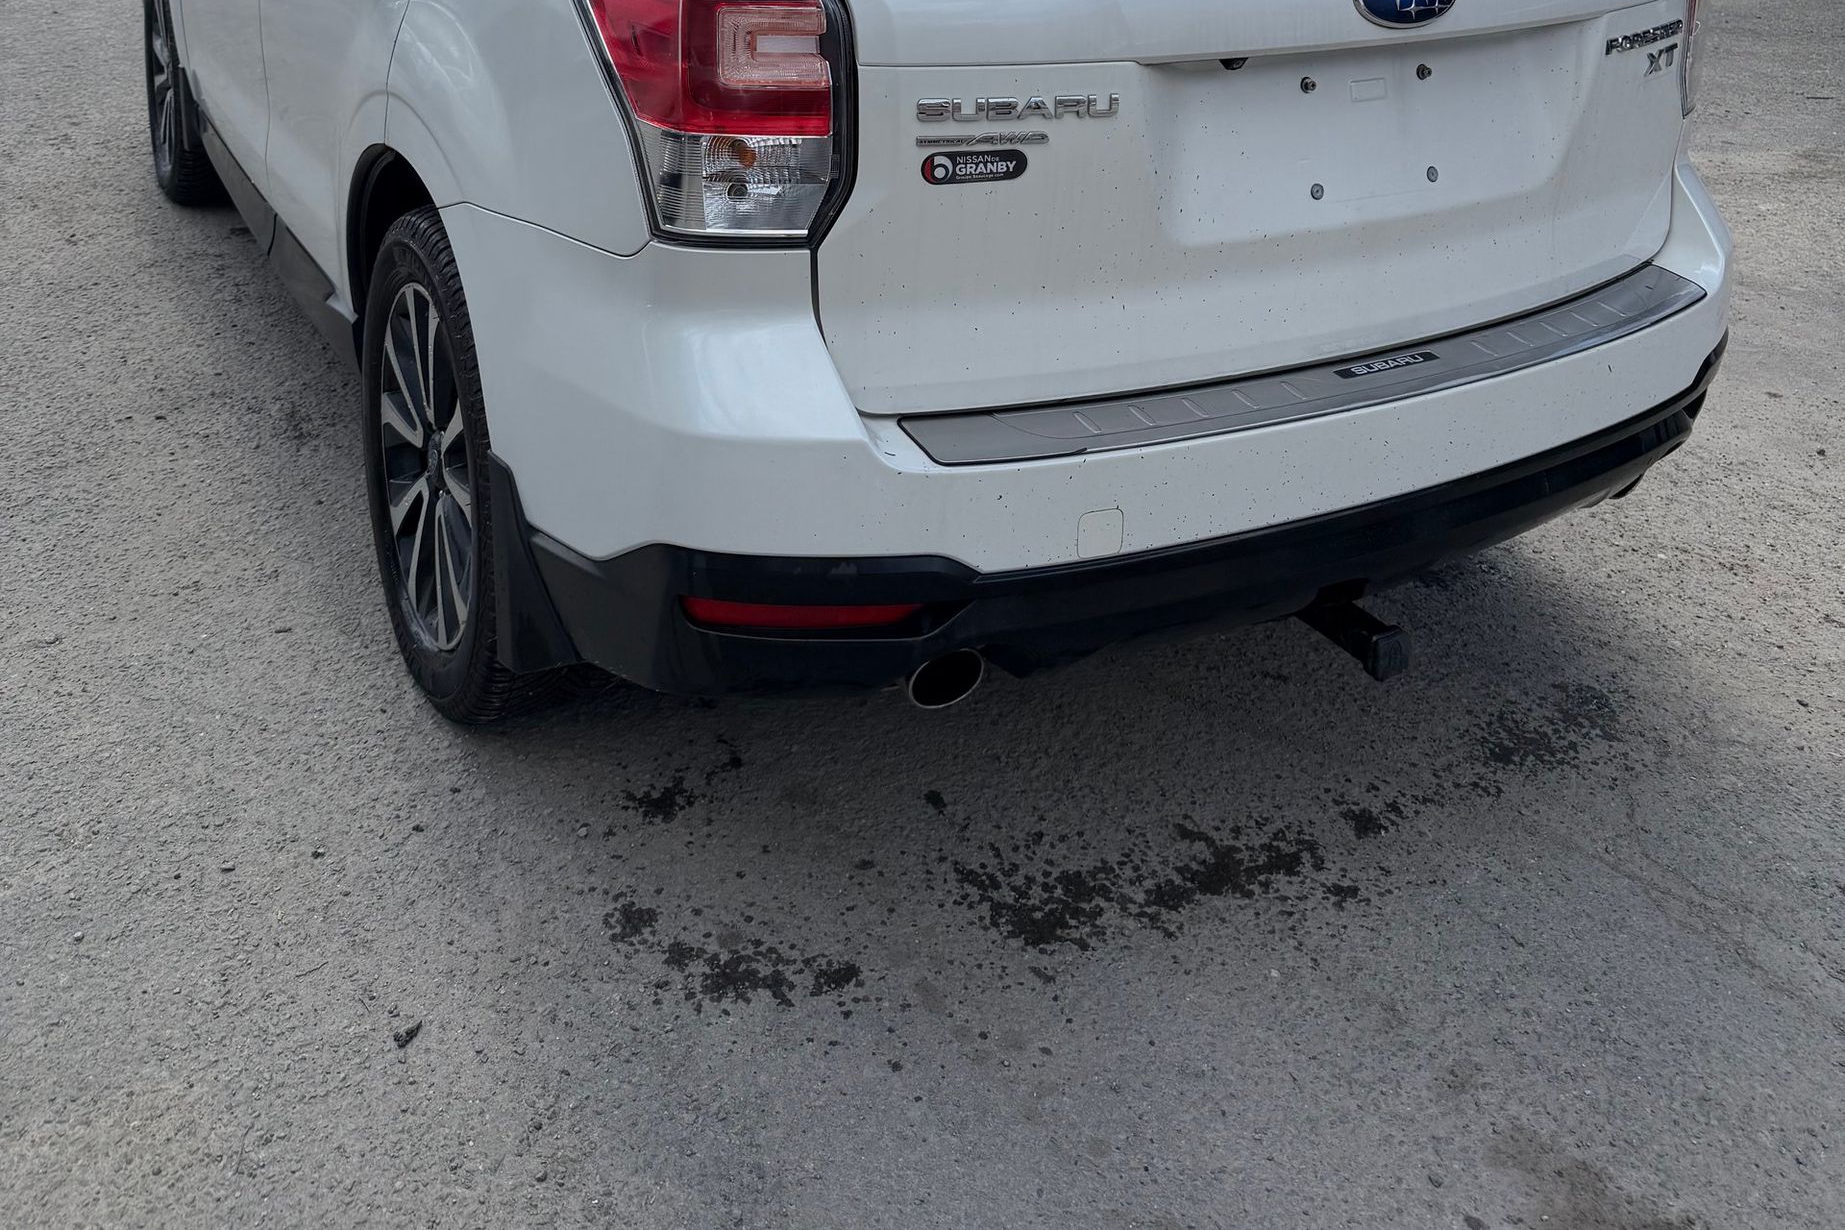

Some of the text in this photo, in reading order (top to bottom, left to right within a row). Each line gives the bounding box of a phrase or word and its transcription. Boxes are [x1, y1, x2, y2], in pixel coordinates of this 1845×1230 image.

[1605, 19, 1684, 56] FORESTER
[1644, 42, 1679, 76] XT
[916, 93, 1120, 121] SUBARU
[966, 131, 1050, 146] AWD
[955, 161, 1016, 175] GRANBY
[956, 154, 991, 164] NISSAN
[1350, 354, 1424, 375] SUBARU
